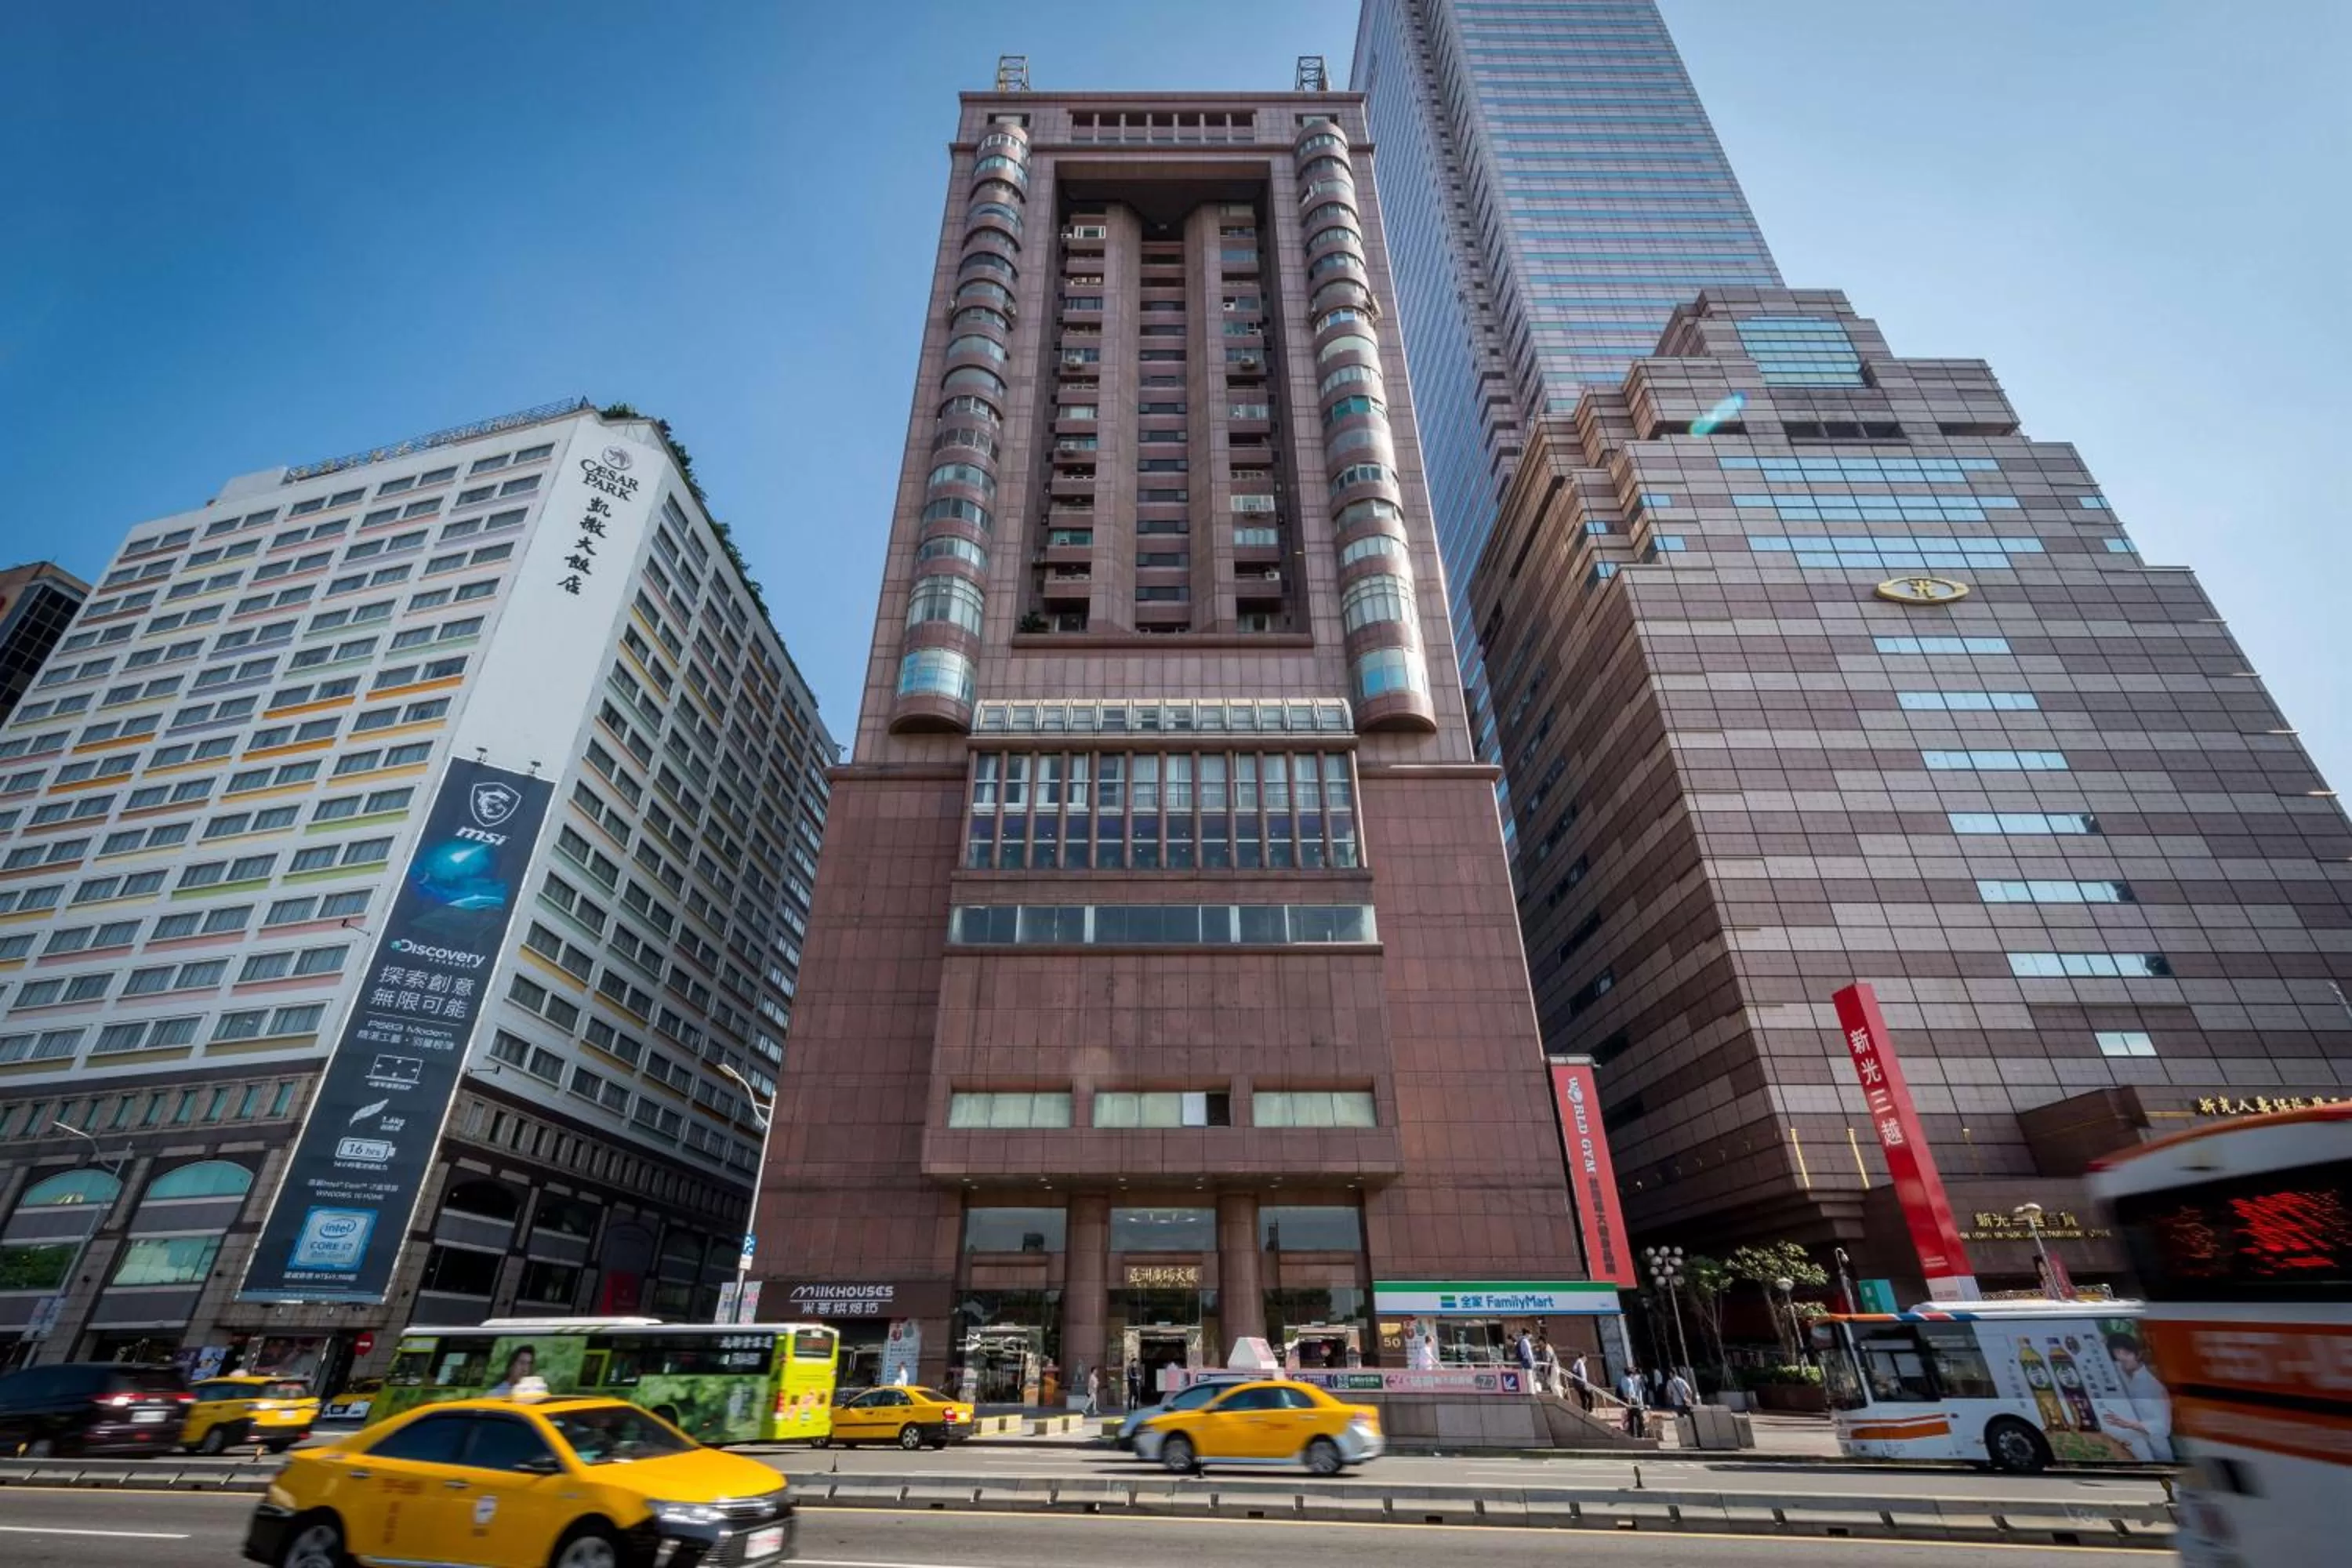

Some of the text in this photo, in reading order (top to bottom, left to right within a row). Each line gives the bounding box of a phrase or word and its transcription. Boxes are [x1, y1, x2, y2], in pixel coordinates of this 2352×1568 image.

[583, 472, 631, 502] PARK
[557, 496, 612, 595] 凱撒大飯店
[455, 826, 508, 847] msi
[399, 938, 485, 967] Discovery
[378, 964, 475, 996] 探索創意
[370, 987, 469, 1018] 無限可能
[406, 1025, 452, 1038] Modern
[1849, 1026, 1904, 1147] 新光三越
[349, 1142, 363, 1155] 16
[1581, 1138, 1596, 1174] GYM
[325, 1221, 352, 1234] intel
[310, 1240, 339, 1251] CORE
[802, 1302, 879, 1316] 米哥烘焙坊
[1461, 1294, 1555, 1310] 全家 FamilyMart
[1383, 1337, 1402, 1348] 50
